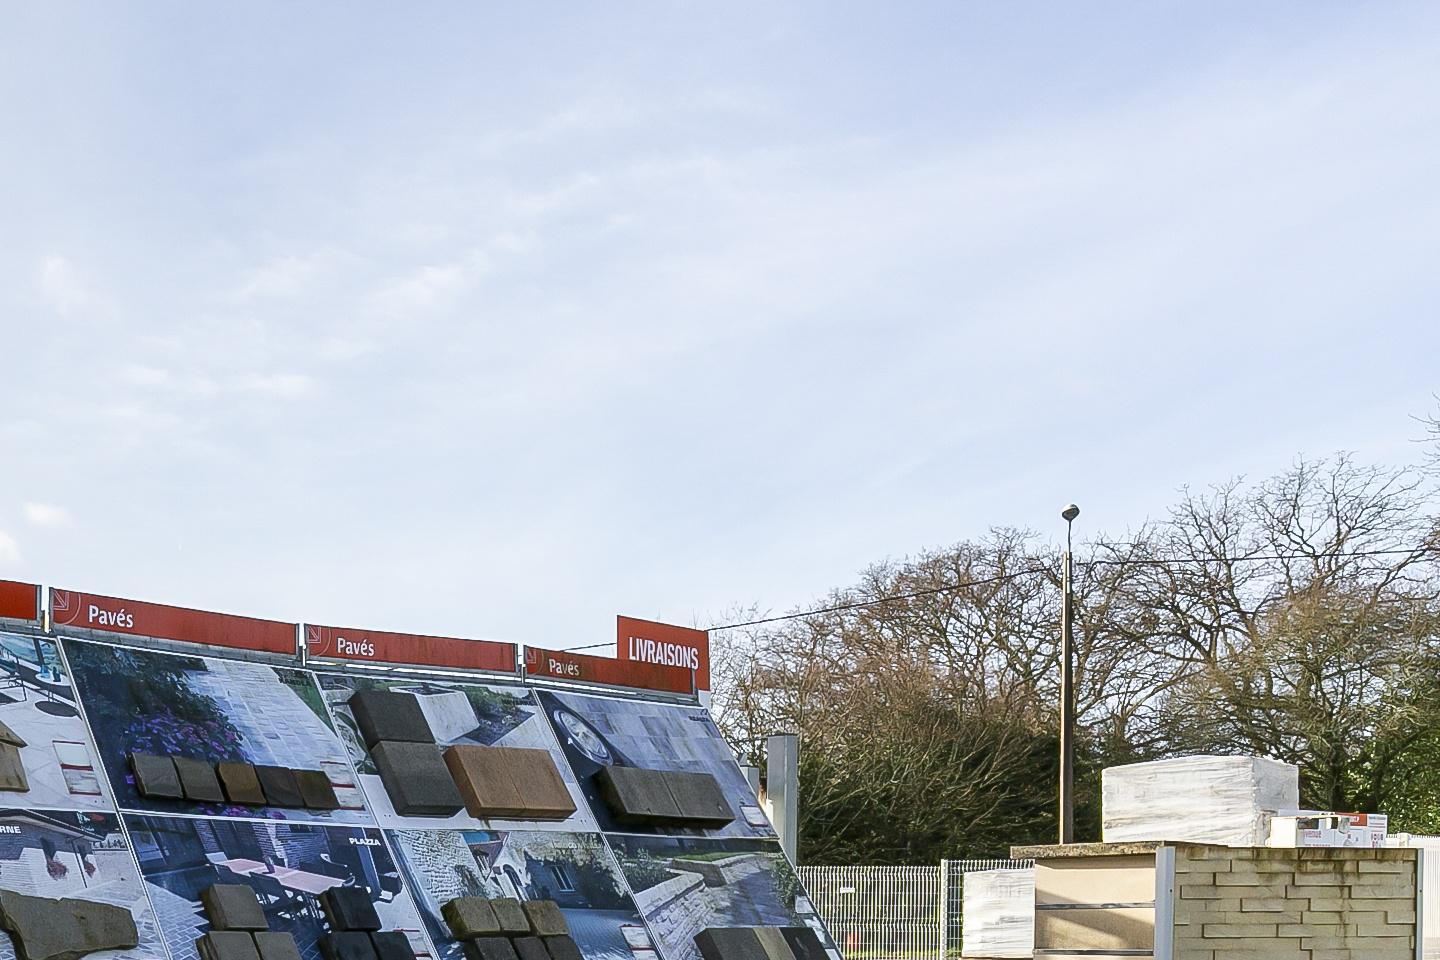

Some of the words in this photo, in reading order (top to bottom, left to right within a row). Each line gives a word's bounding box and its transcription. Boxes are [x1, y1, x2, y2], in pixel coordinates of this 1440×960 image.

[89, 604, 133, 628] Pavés
[337, 637, 374, 656] Pavés
[629, 636, 699, 670] LIVRAISONS
[549, 658, 579, 676] Pavés
[348, 837, 381, 846] PLAZZA
